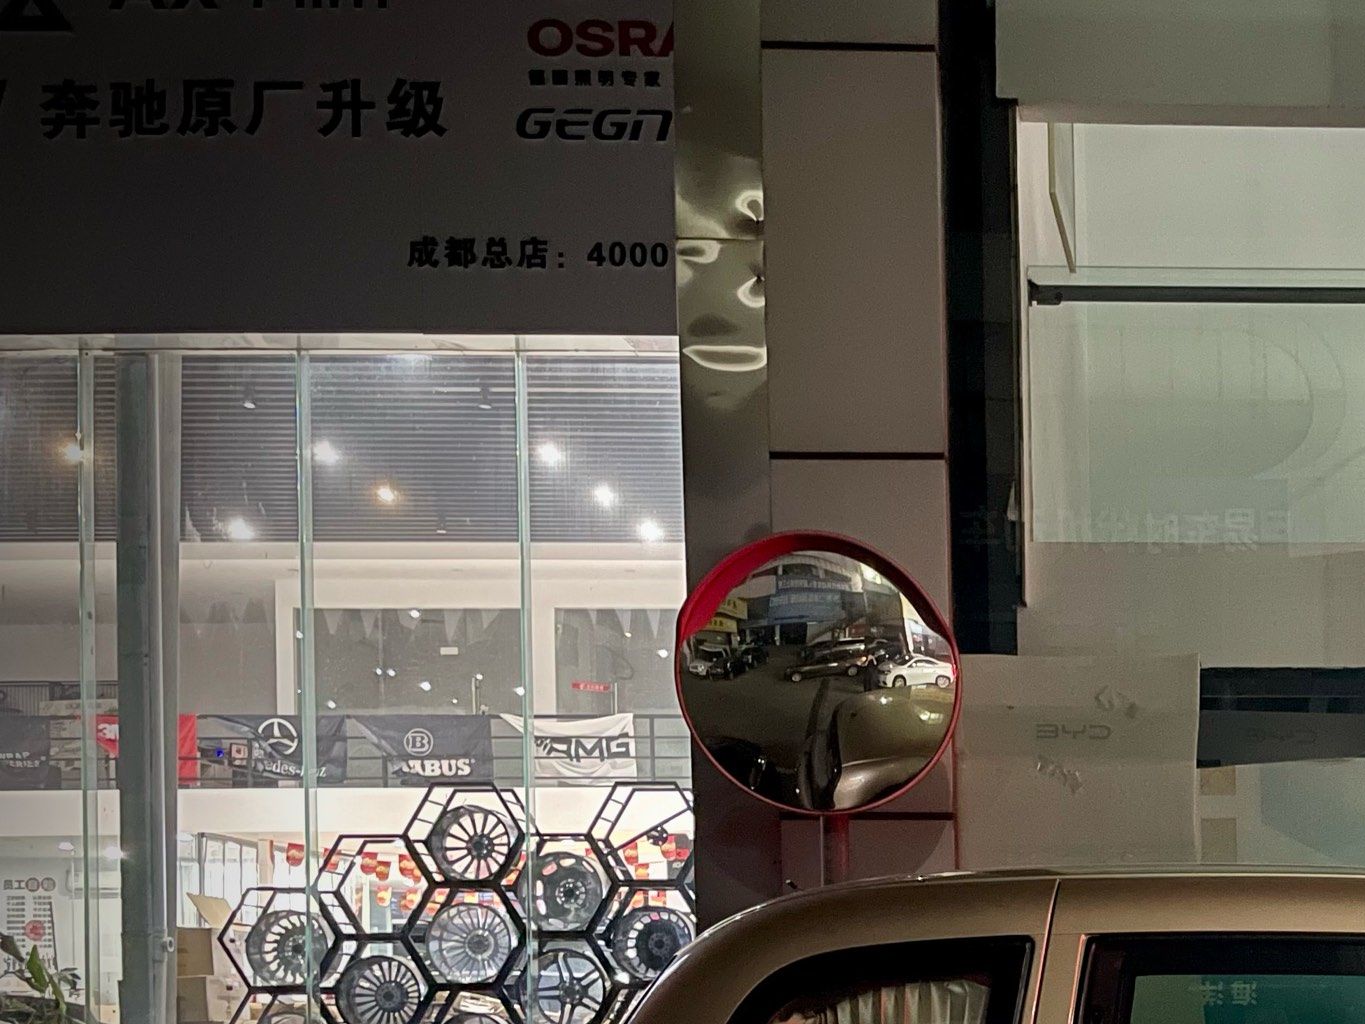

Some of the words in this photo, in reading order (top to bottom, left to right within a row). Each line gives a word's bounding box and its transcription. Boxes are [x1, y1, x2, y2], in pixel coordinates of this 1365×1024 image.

[39, 78, 448, 138] 奔驰原厂升级
[587, 242, 668, 267] 4000
[1035, 723, 1112, 741] BYD
